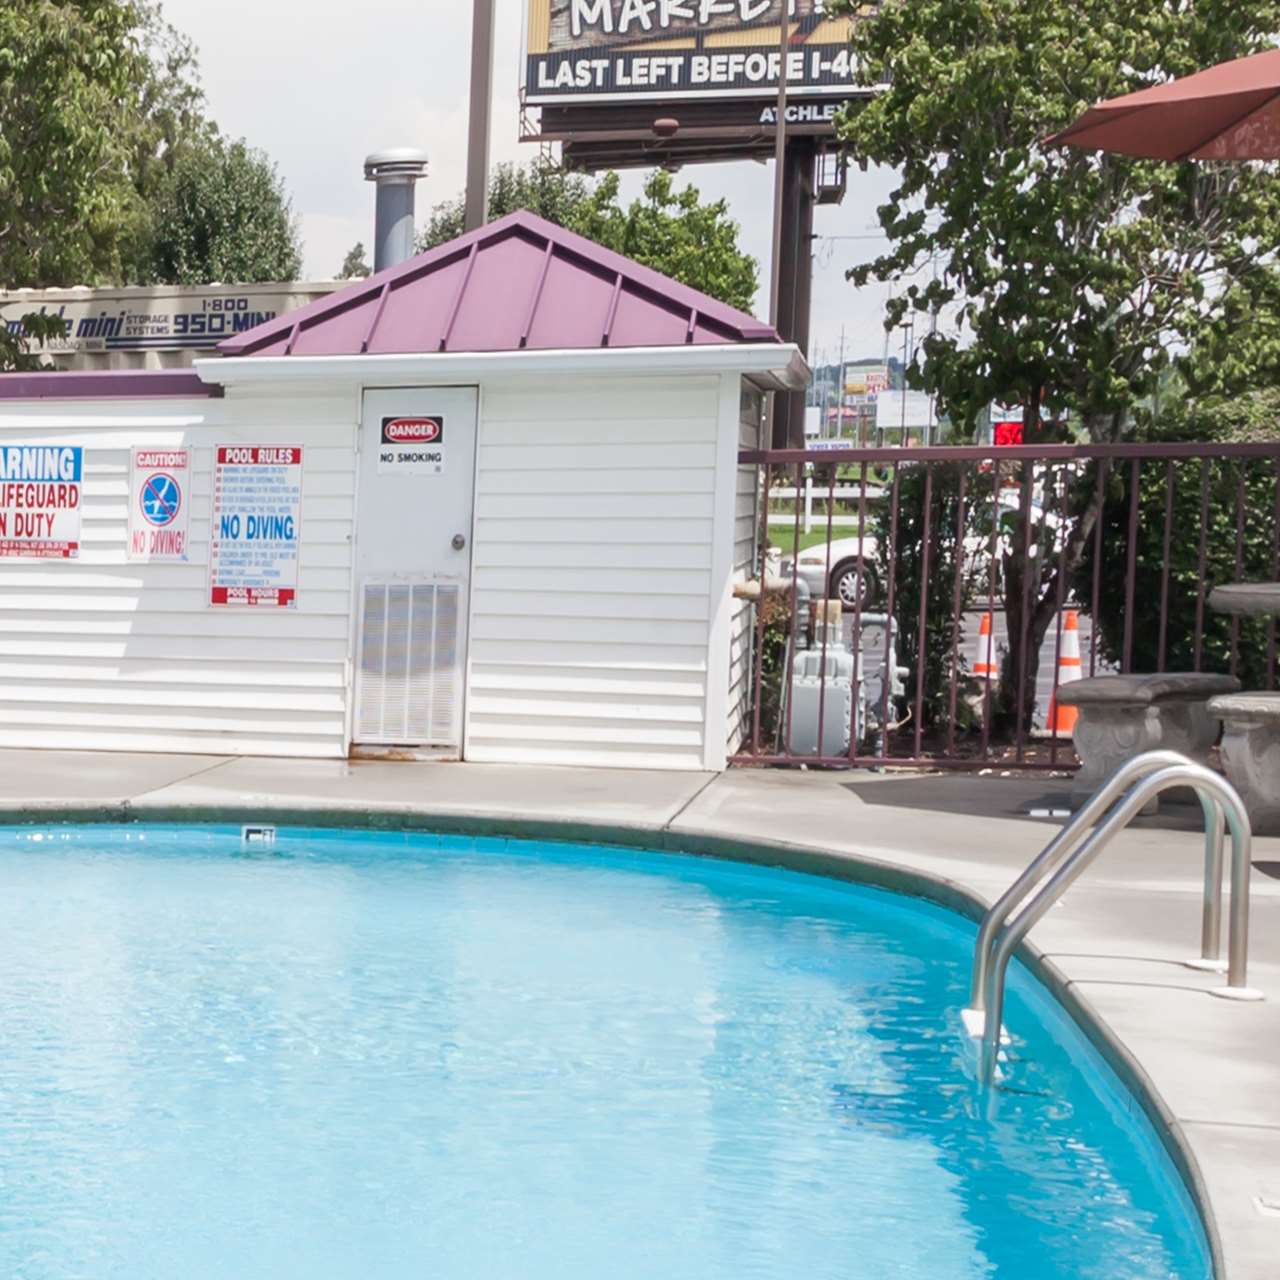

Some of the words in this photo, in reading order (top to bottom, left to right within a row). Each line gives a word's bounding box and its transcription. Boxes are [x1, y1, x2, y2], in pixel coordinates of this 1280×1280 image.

[571, 0, 823, 36] MARK
[538, 59, 609, 88] LAST
[616, 56, 684, 86] LEFT
[690, 52, 803, 83] BEFORE
[76, 310, 126, 337] mini
[125, 325, 169, 335] SYSTEMS
[126, 315, 169, 324] STORAGE
[389, 425, 434, 436] DANGER
[226, 448, 254, 463] POOL
[258, 448, 293, 463] RULES
[380, 453, 394, 463] NO
[398, 452, 442, 463] SMOKING
[15, 513, 55, 537] DUTY
[221, 515, 240, 540] NO
[132, 531, 145, 553] NO
[149, 531, 185, 554] DIVING!
